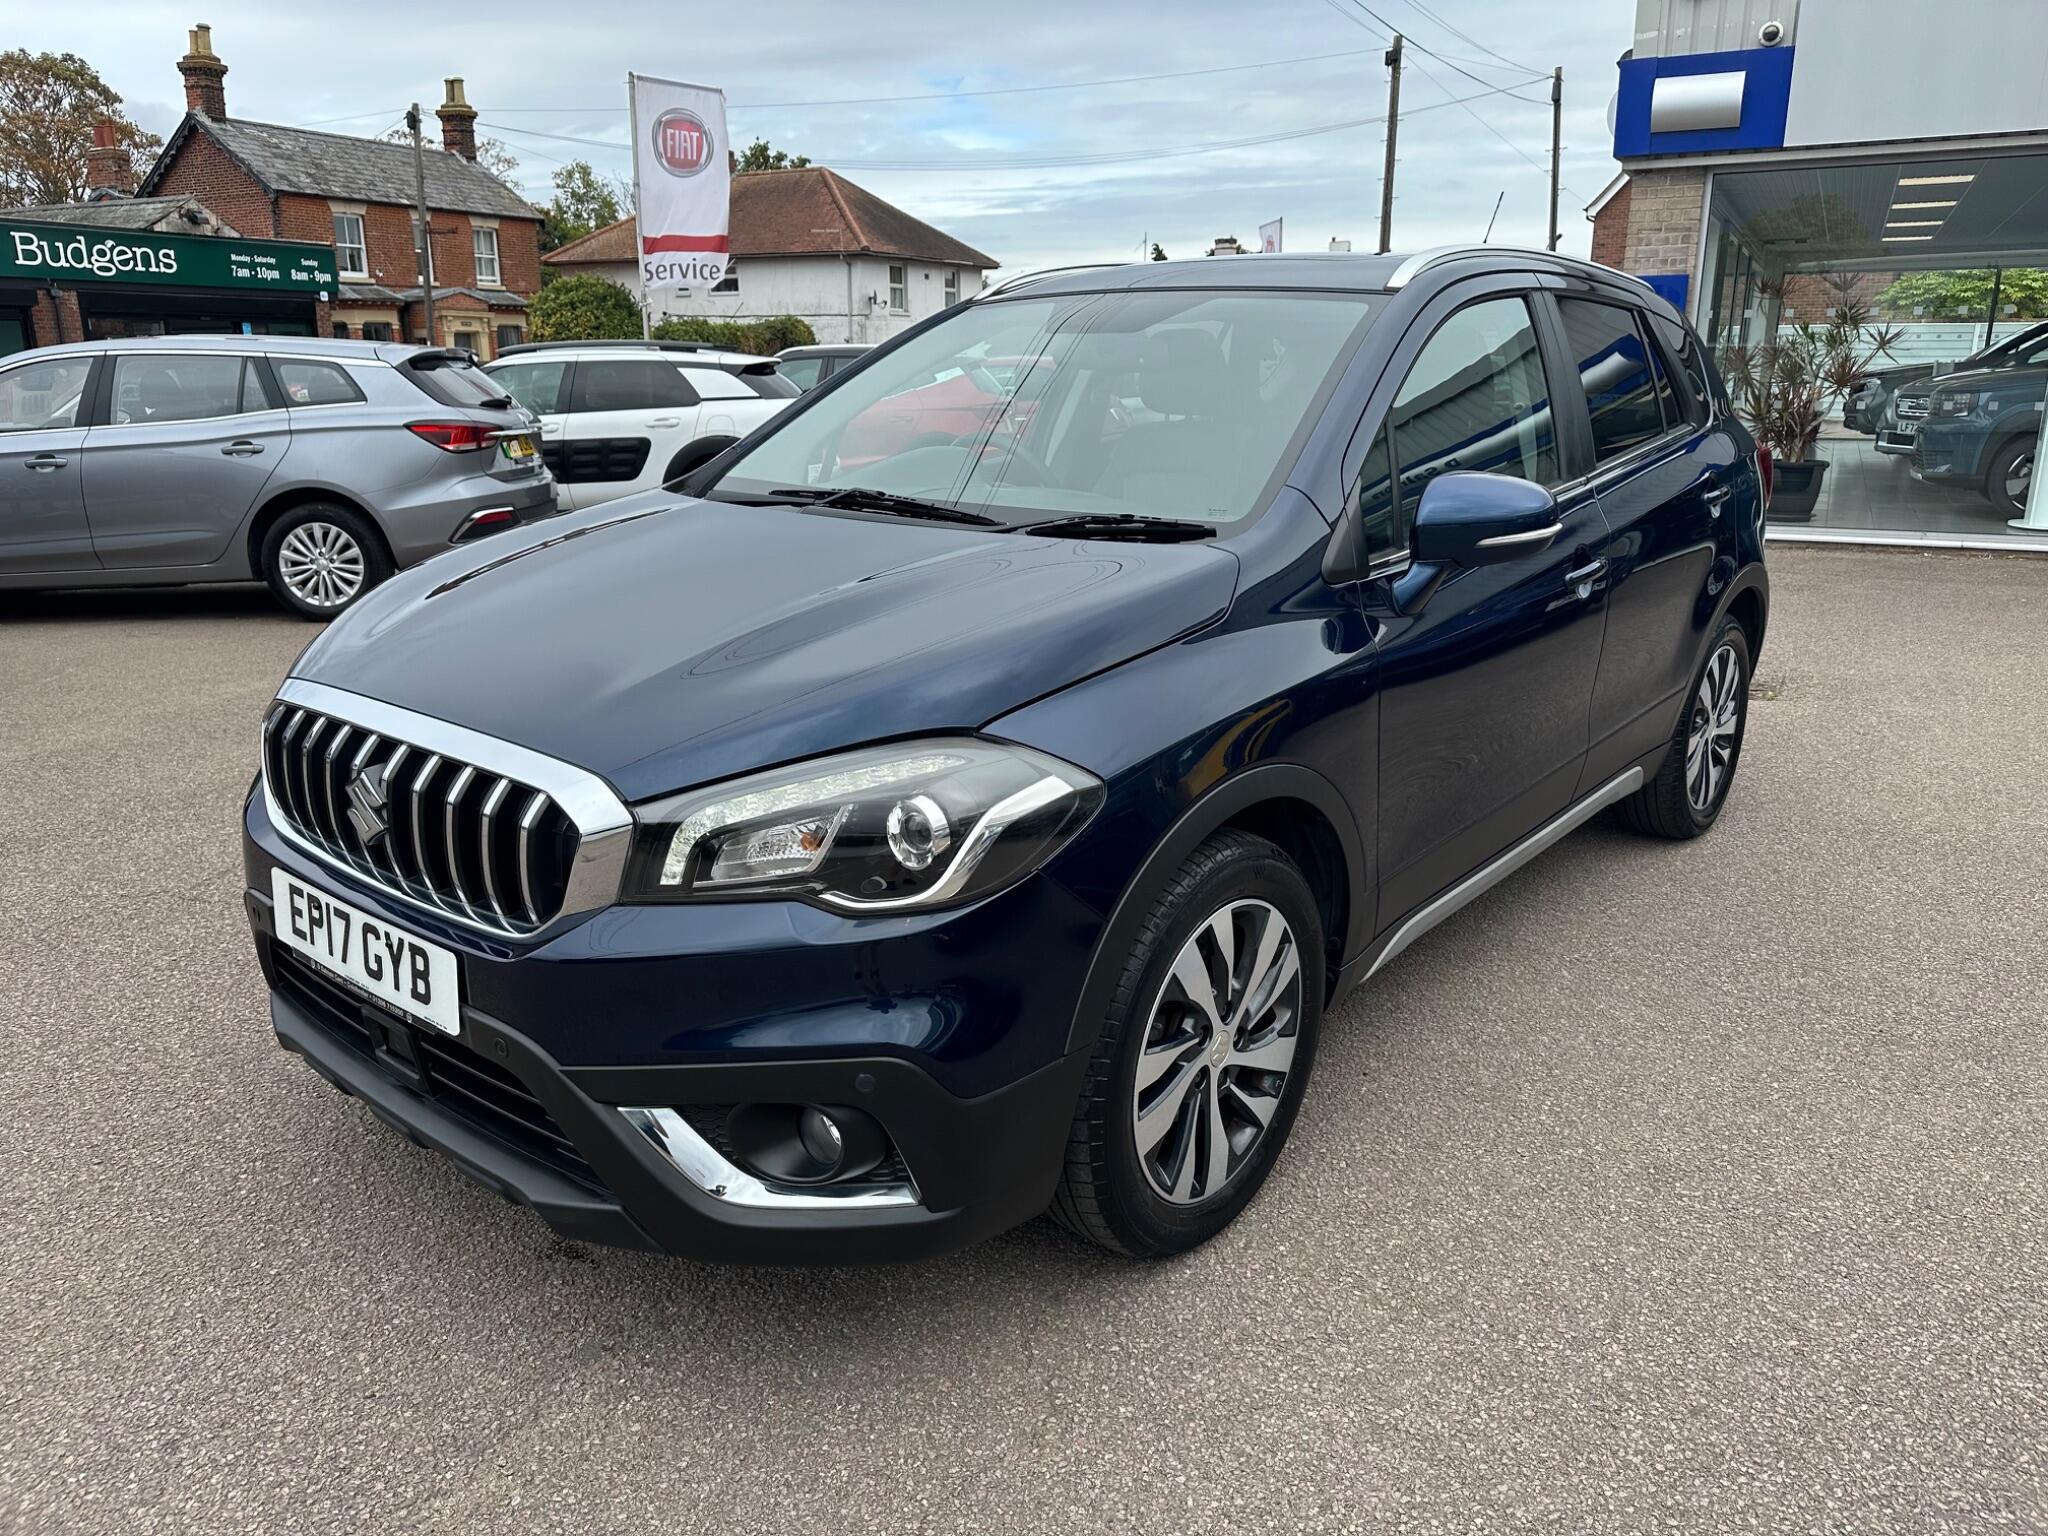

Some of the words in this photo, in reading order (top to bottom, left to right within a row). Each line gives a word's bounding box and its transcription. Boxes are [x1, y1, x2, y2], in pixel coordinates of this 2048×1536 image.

[666, 128, 699, 160] FIAT
[10, 231, 178, 276] Budgens
[231, 254, 250, 263] Monday
[254, 255, 276, 265] Saturday
[301, 258, 318, 268] Sunday
[231, 265, 250, 278] 7am
[257, 267, 280, 281] 10pm
[291, 269, 309, 281] 8am
[314, 270, 332, 284] 9pm
[645, 258, 720, 281] Service
[288, 882, 351, 964] EP17
[361, 921, 432, 1006] GYB
